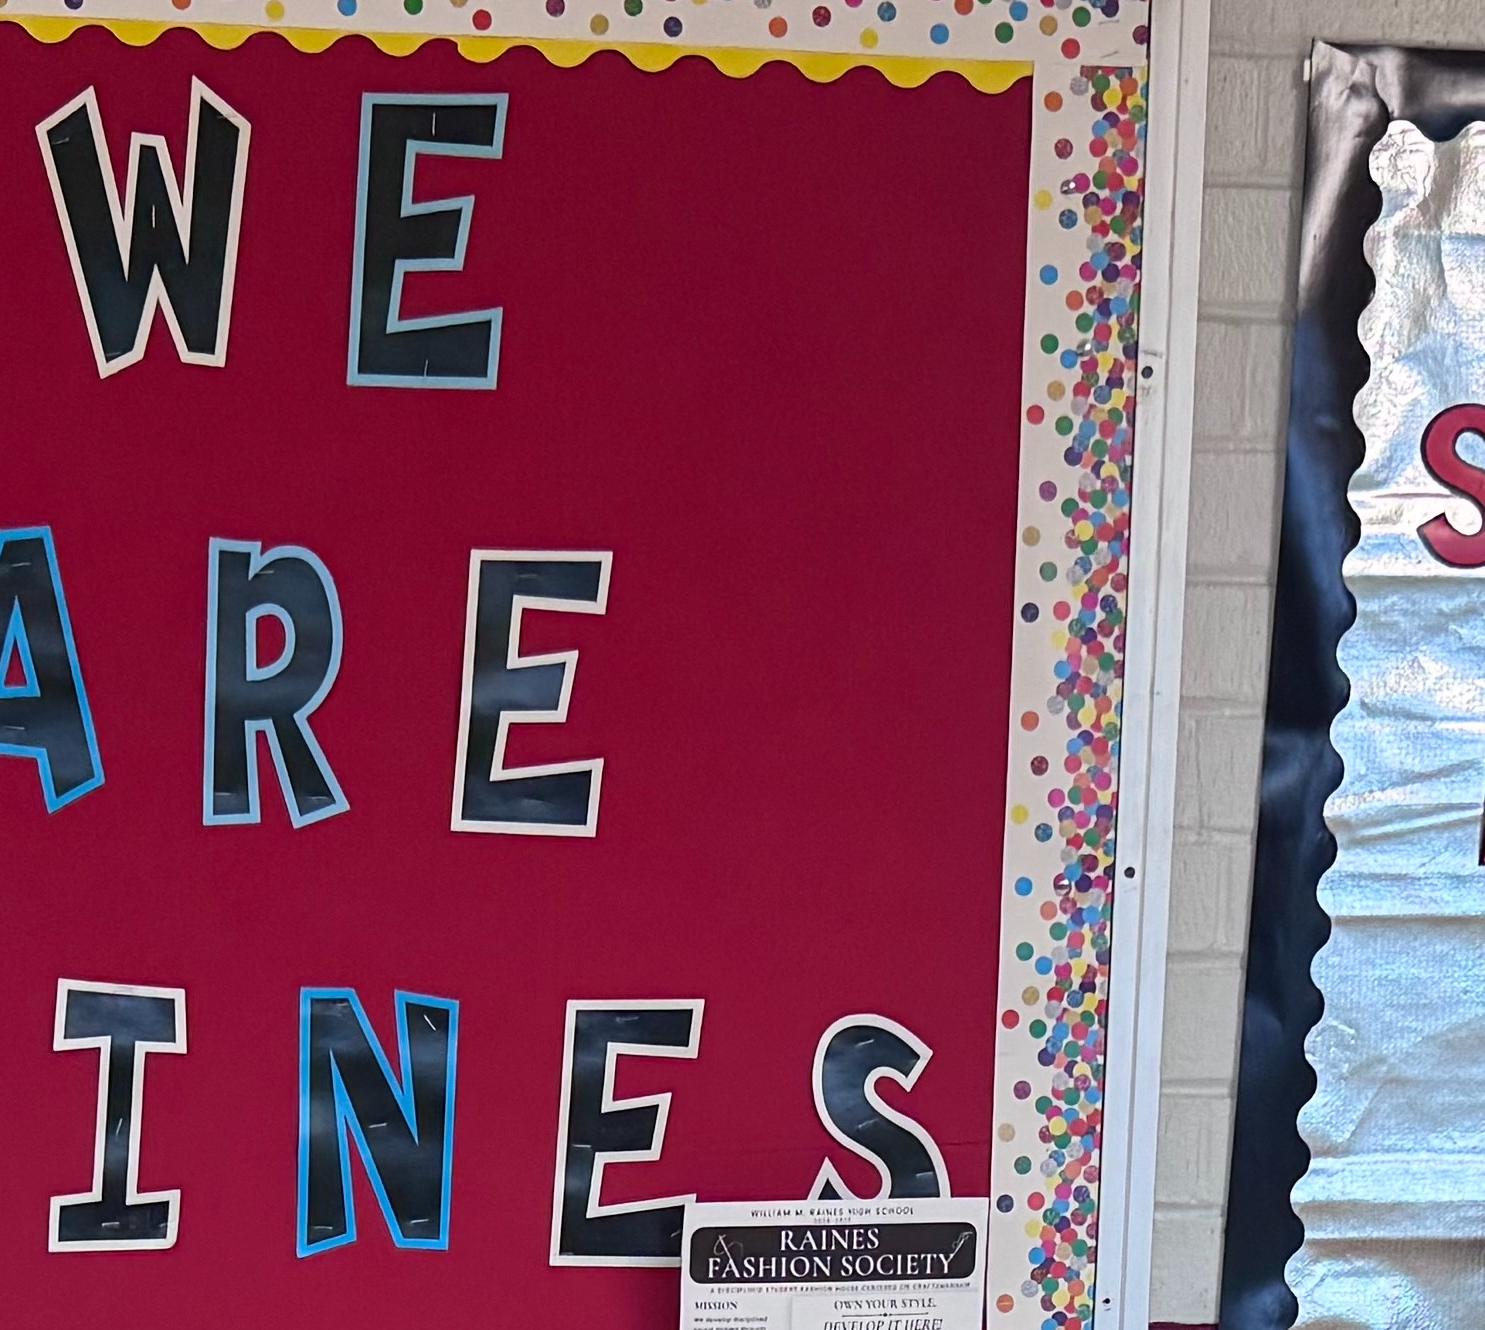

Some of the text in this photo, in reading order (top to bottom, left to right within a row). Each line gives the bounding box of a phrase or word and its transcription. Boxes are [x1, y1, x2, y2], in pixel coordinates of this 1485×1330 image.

[35, 76, 509, 390] WE
[779, 1228, 880, 1252] RAINES
[706, 1252, 955, 1280] FASHION SOCIETY
[865, 1298, 897, 1310] YOUR
